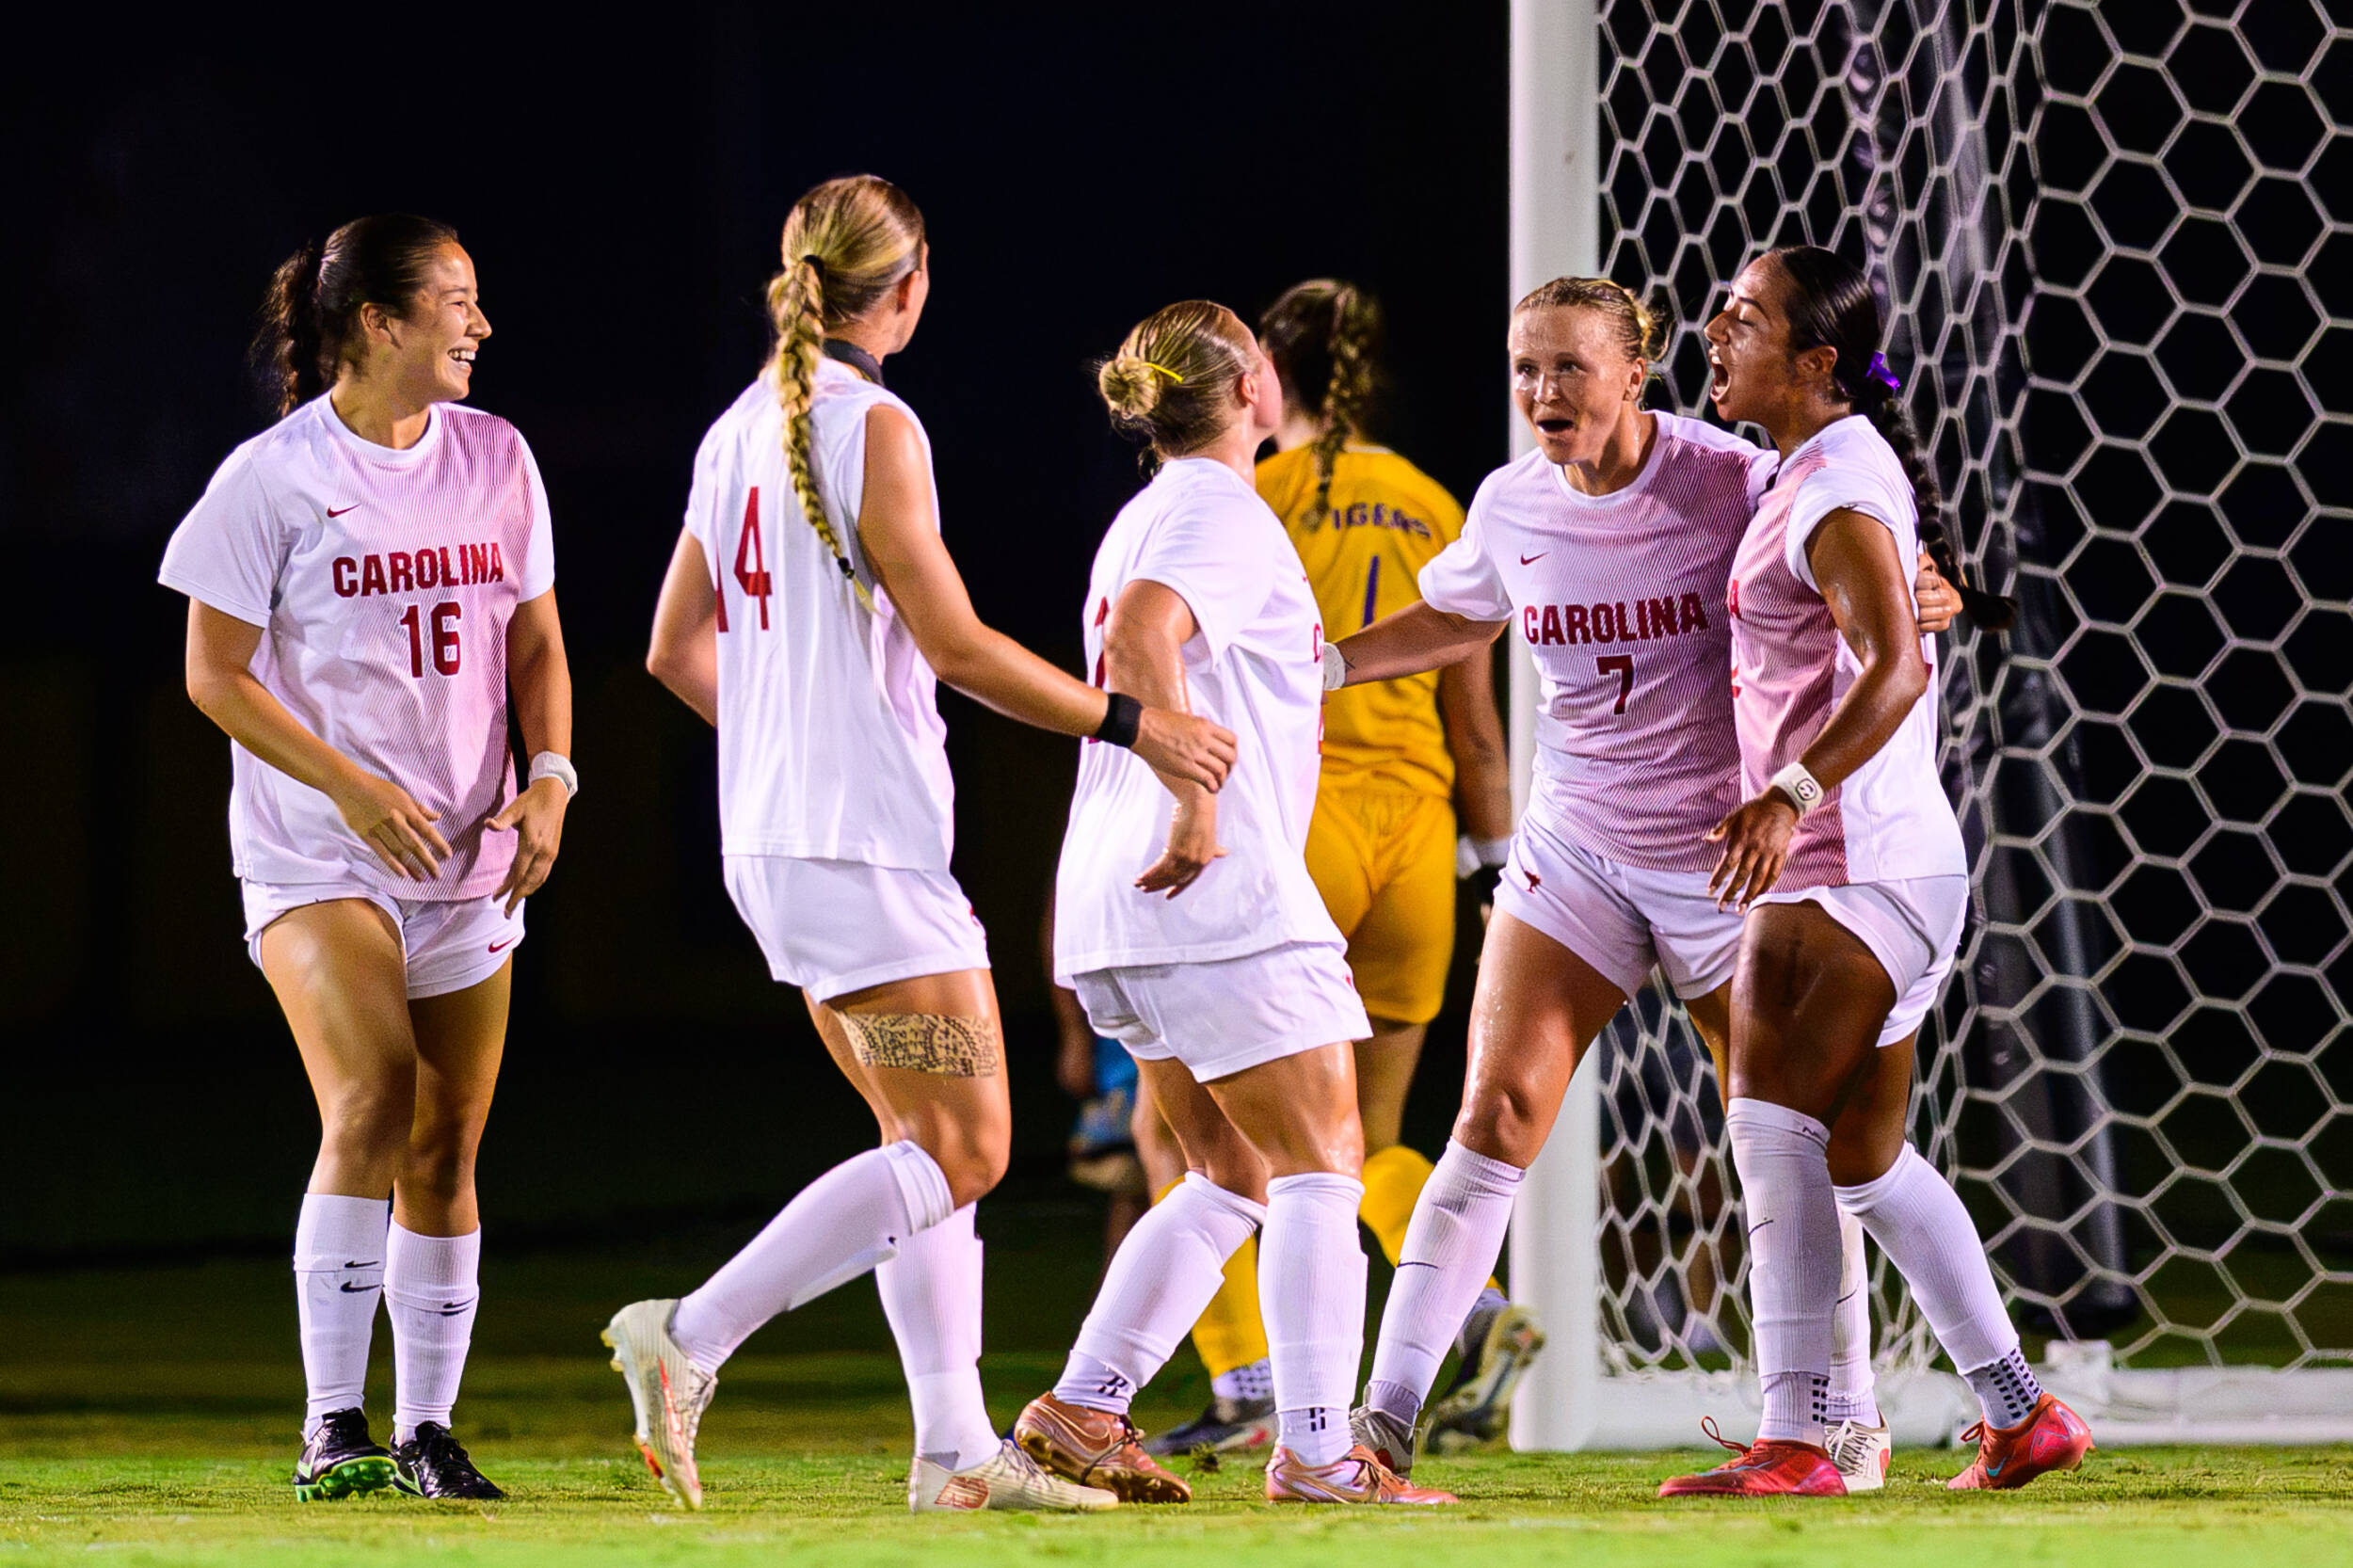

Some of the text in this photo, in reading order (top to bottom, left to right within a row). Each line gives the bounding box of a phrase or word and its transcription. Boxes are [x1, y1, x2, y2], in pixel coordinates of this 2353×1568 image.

[1333, 503, 1431, 538] IGERS
[331, 542, 504, 598] CAROLINA
[399, 601, 462, 679] 16
[1523, 591, 1710, 646] CAROLINA
[1595, 654, 1634, 716] 7
